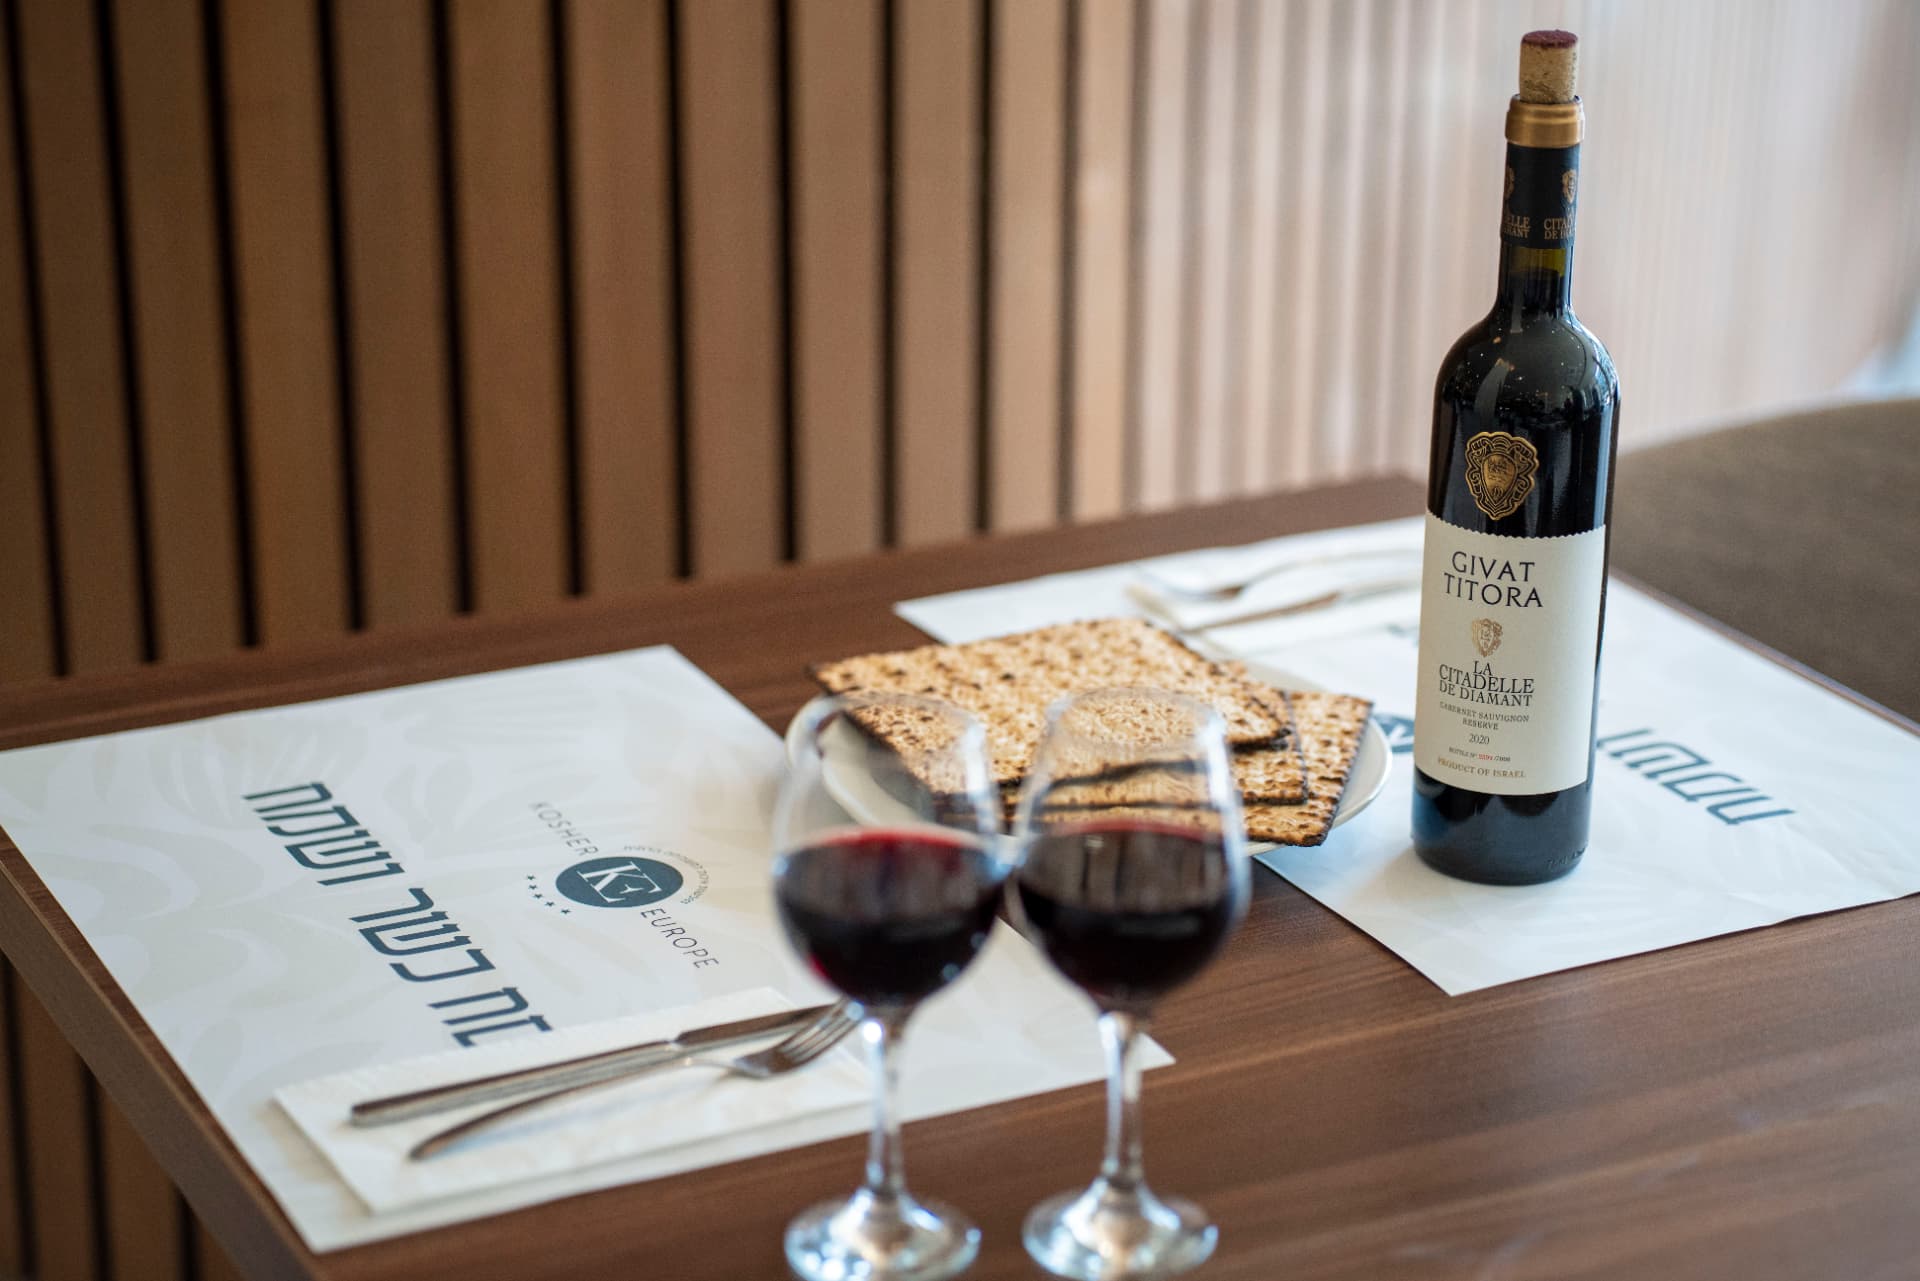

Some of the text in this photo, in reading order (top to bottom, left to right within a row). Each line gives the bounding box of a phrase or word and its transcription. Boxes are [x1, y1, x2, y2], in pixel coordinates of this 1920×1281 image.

[1452, 551, 1536, 582] GIVAT
[1443, 572, 1544, 608] TITORA
[1439, 663, 1535, 694] CITADELLE
[1472, 660, 1494, 677] LA
[1439, 679, 1533, 707] DE DIAMANT
[1440, 700, 1530, 723] CABERNET SAUVIGNON
[1462, 717, 1499, 731] RESERVE
[1468, 732, 1490, 745] 2020
[1438, 756, 1475, 775] PRODUCT
[1477, 767, 1490, 777] OF
[1493, 769, 1526, 778] ISRAEL
[241, 781, 406, 886] ושמח
[529, 800, 600, 858] KOSHER
[347, 887, 497, 983] כשר
[640, 907, 720, 969] EUROPE
